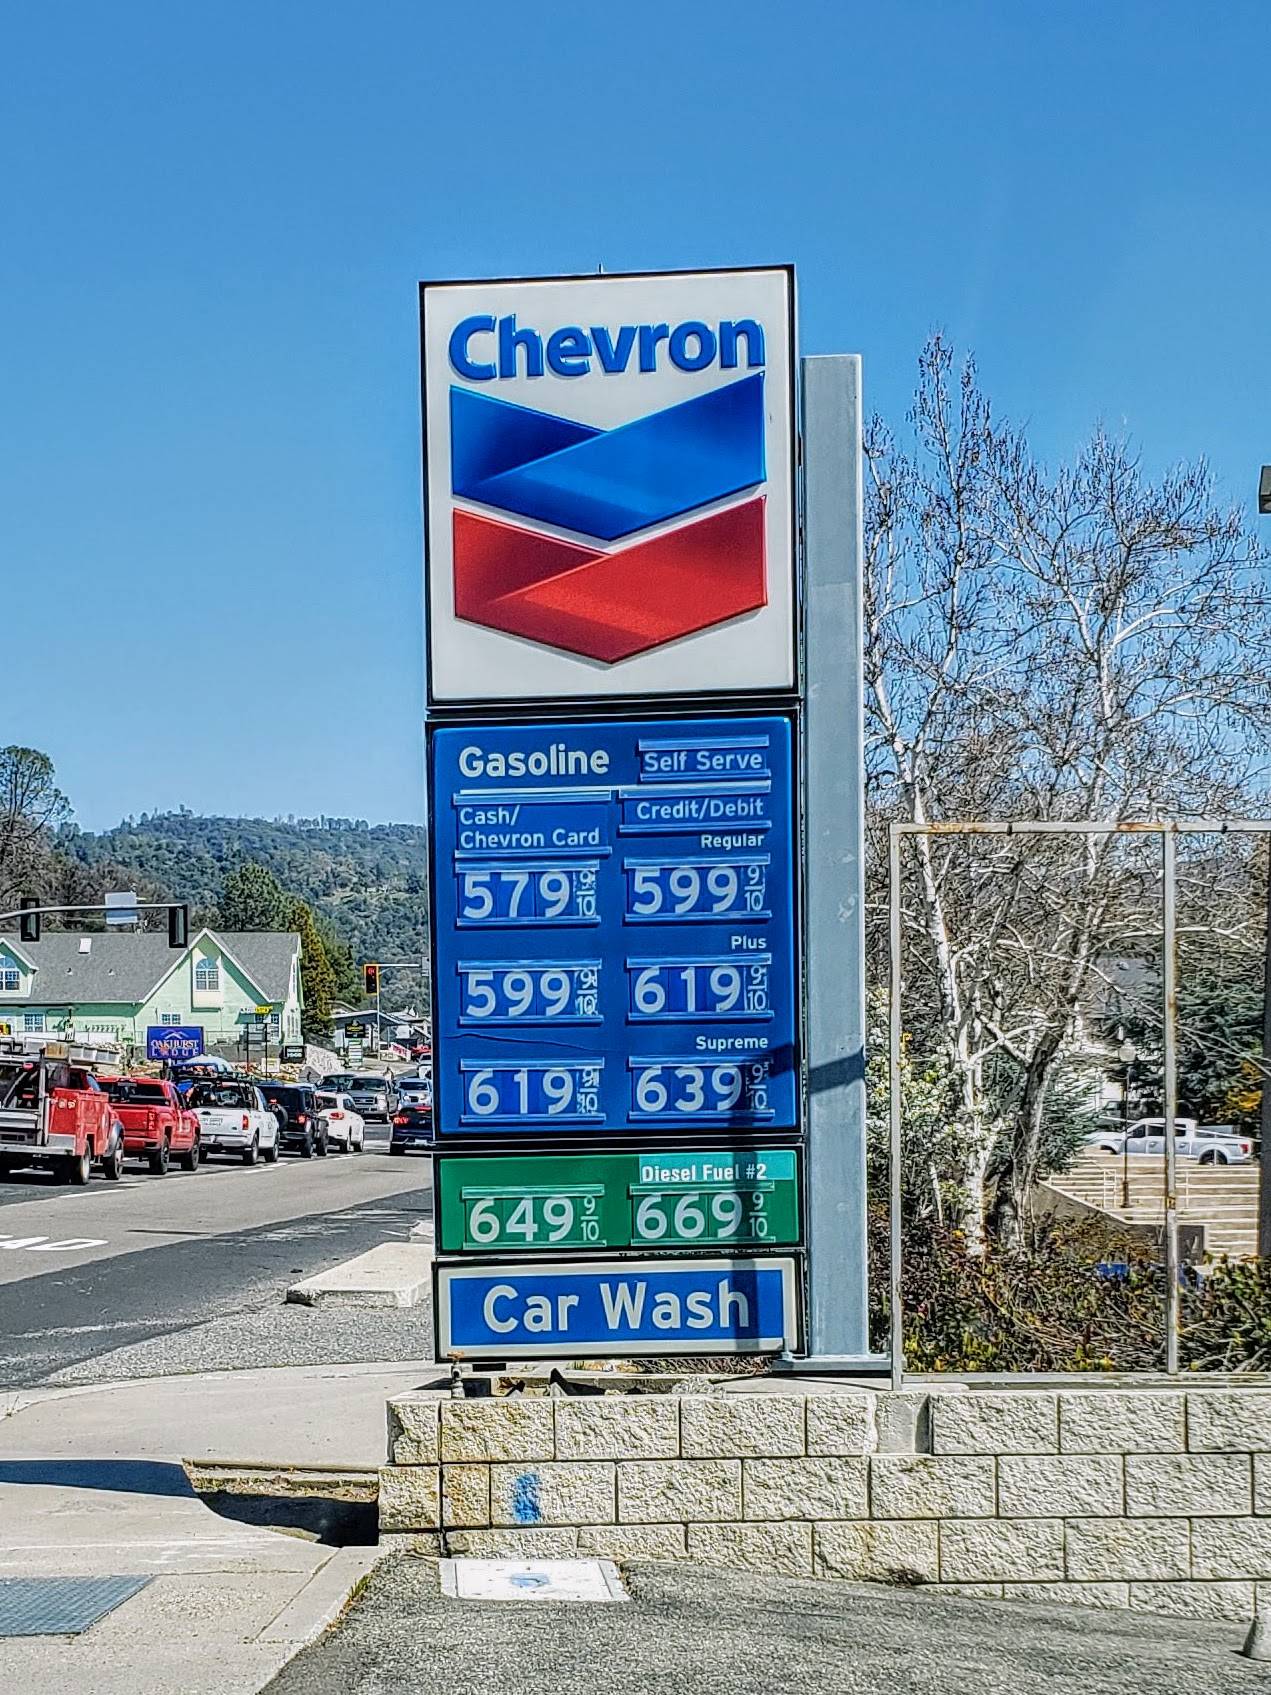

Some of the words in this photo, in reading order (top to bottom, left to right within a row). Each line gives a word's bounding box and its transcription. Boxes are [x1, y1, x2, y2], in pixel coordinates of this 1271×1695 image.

[449, 313, 766, 381] Chevron
[459, 744, 610, 777] Gasoline
[643, 750, 688, 772] Self
[696, 749, 763, 771] Serve
[459, 804, 520, 826] Cash/
[636, 797, 765, 821] Credit/Debit
[460, 832, 545, 850] Chevron
[552, 828, 600, 847] Card
[701, 834, 765, 851] Regular
[463, 871, 571, 919] 579
[633, 866, 739, 915] 599
[731, 935, 768, 950] Plus
[465, 971, 571, 1018] 599
[634, 966, 741, 1014] 619
[151, 1040, 200, 1050] OAKHURST
[696, 1036, 769, 1053] Supreme
[468, 1070, 574, 1116] 619
[635, 1066, 741, 1114] 639
[642, 1165, 697, 1183] Diesel
[703, 1164, 742, 1182] Fuel
[745, 1163, 768, 1180] #2
[468, 1195, 574, 1244] 649
[636, 1192, 742, 1241] 669
[483, 1285, 580, 1333] Car
[600, 1279, 749, 1330] Wash
